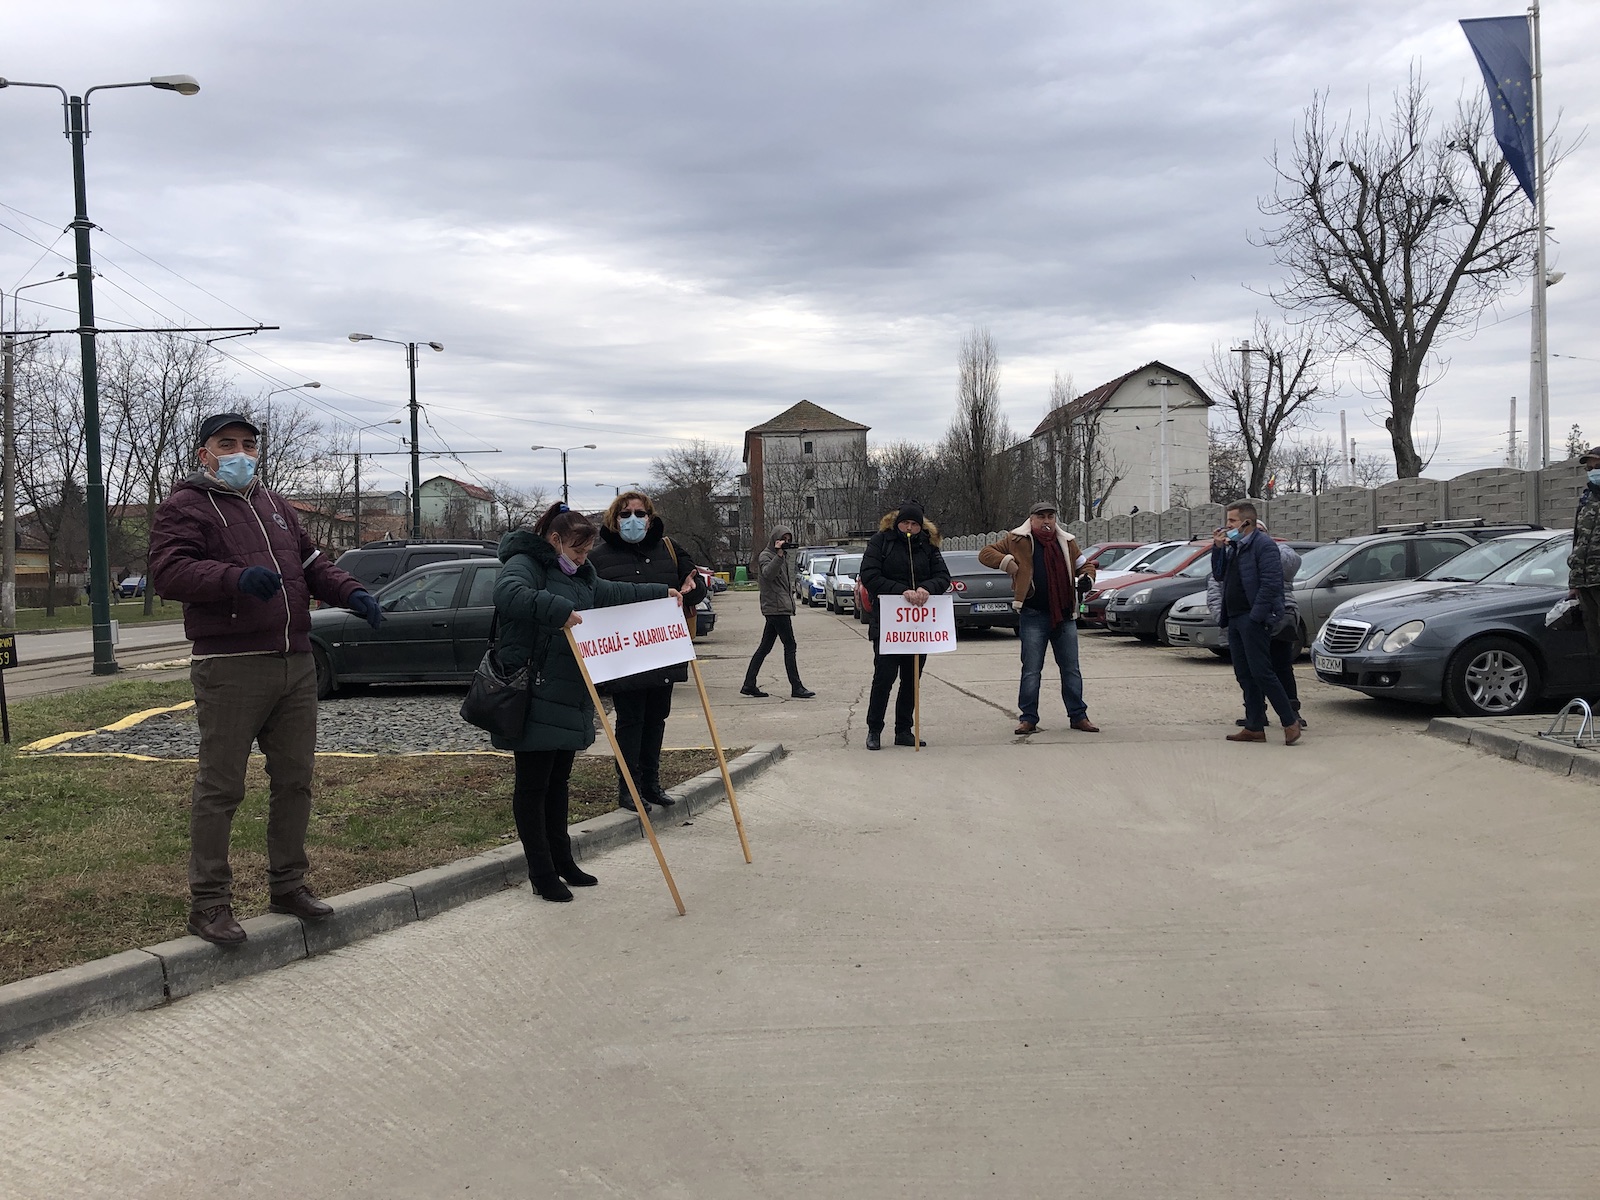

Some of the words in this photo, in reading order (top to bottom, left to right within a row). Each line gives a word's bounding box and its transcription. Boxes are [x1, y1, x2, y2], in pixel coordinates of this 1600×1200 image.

[896, 607, 929, 623] STOP
[597, 631, 623, 655] EGALĂ
[623, 637, 631, 646] =
[633, 626, 669, 648] SALARIUL
[667, 623, 688, 640] EGAL
[885, 630, 949, 643] ABUZURILOR
